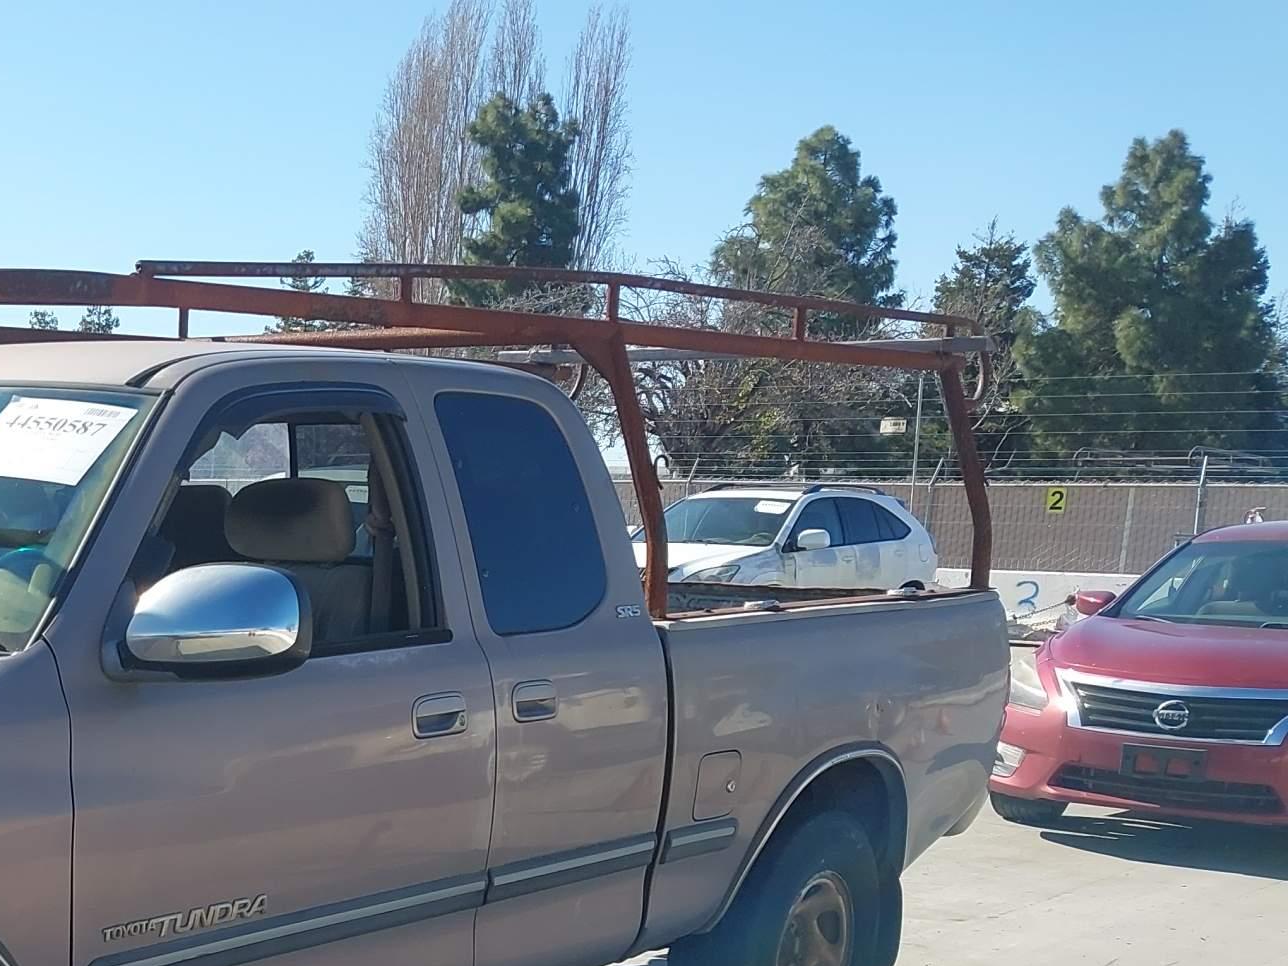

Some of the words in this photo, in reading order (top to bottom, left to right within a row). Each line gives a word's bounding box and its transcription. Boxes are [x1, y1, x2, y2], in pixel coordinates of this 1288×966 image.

[5, 415, 108, 437] 44550587
[1049, 490, 1064, 511] 2
[616, 605, 641, 618] SR5
[102, 920, 156, 943] TOYOTA
[152, 893, 268, 938] TUNDRA
